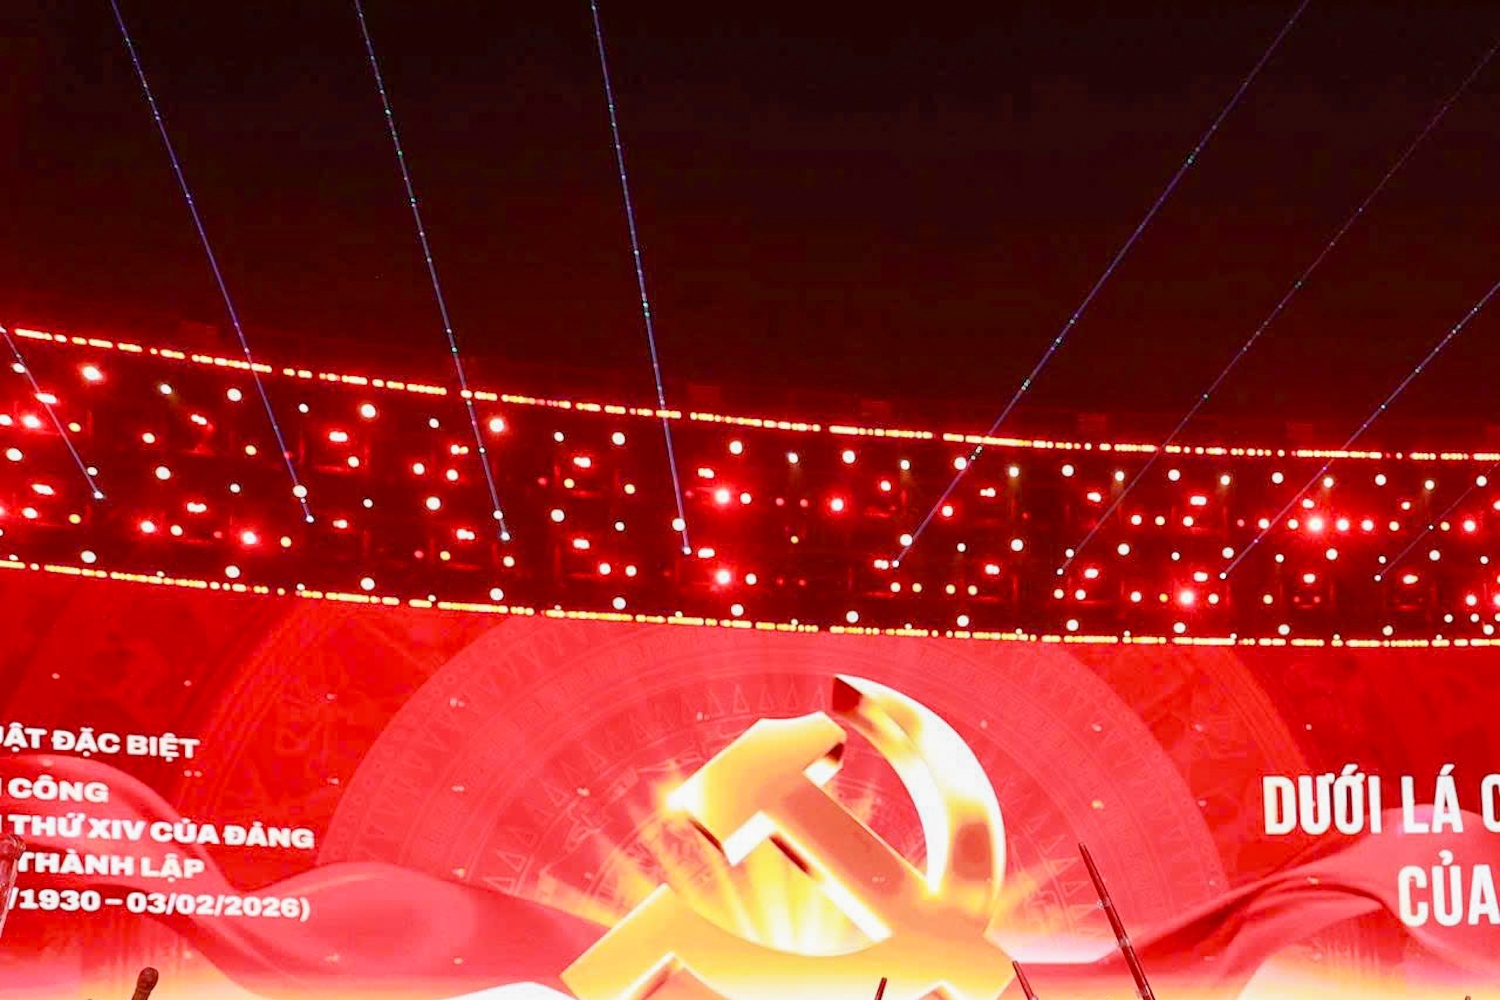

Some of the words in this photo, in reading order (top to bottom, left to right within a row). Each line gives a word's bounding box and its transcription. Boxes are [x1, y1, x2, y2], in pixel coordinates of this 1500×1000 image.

[51, 727, 120, 757] ĐẶC
[127, 732, 200, 762] BIỆT
[8, 775, 109, 803] CÔNG
[1263, 764, 1382, 835] DƯỚI
[1401, 764, 1464, 834] LÁ
[7, 812, 86, 839] THỨ
[86, 817, 146, 841] XIV
[149, 818, 220, 845] CỦA
[223, 820, 314, 849] ĐẢNG
[17, 848, 135, 876] THÀNH
[140, 852, 205, 883] LẬP
[1397, 849, 1500, 928] CỦA
[126, 892, 311, 922] 03/02/2026)
